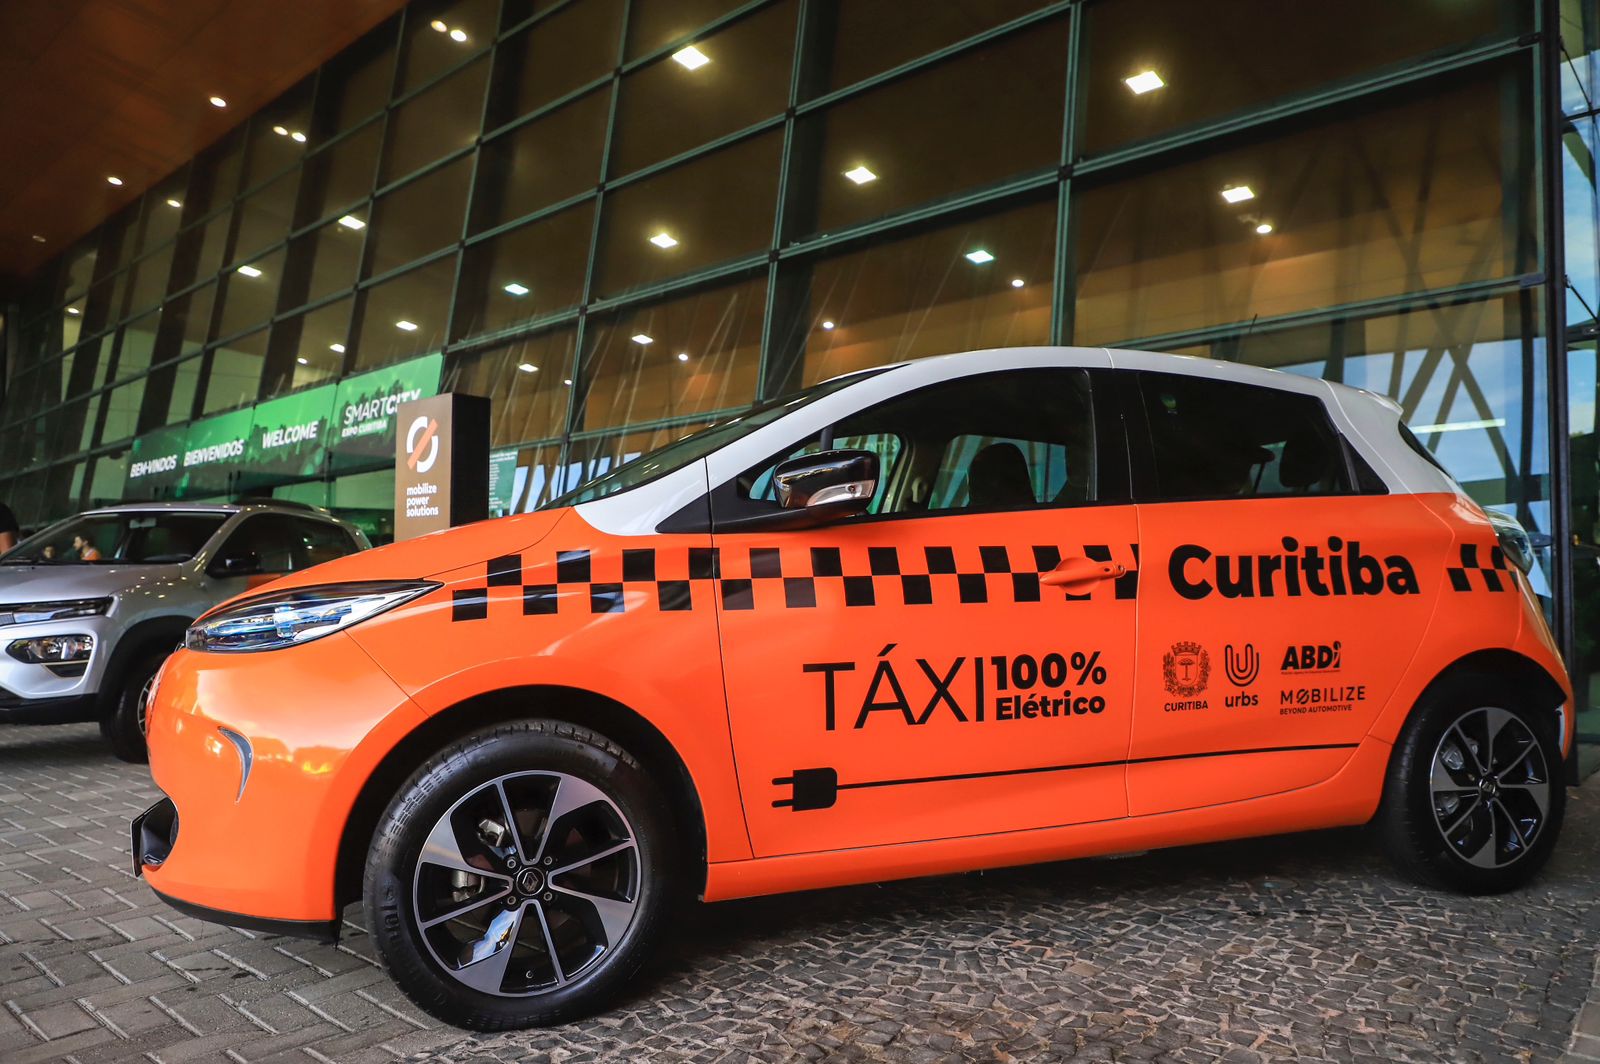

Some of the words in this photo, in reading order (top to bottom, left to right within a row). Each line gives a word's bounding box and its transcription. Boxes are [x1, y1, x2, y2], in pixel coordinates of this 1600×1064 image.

[262, 421, 319, 449] WELCOME
[341, 425, 359, 437] EXPO
[184, 439, 244, 467] BIENVENIDOS
[130, 454, 178, 478] BEM-VINDOS
[406, 482, 438, 496] mobilize
[406, 496, 430, 509] power
[406, 504, 439, 517] solutions
[1168, 536, 1420, 600] Curitiba
[991, 651, 1107, 691] 100%
[803, 643, 985, 731] TÁXI
[996, 690, 1106, 721] Elétrico
[1164, 700, 1209, 712] CURITIBA
[1225, 691, 1259, 708] urbs
[1280, 707, 1307, 715] BEYOND
[1308, 704, 1353, 713] AUTOMOTIVE
